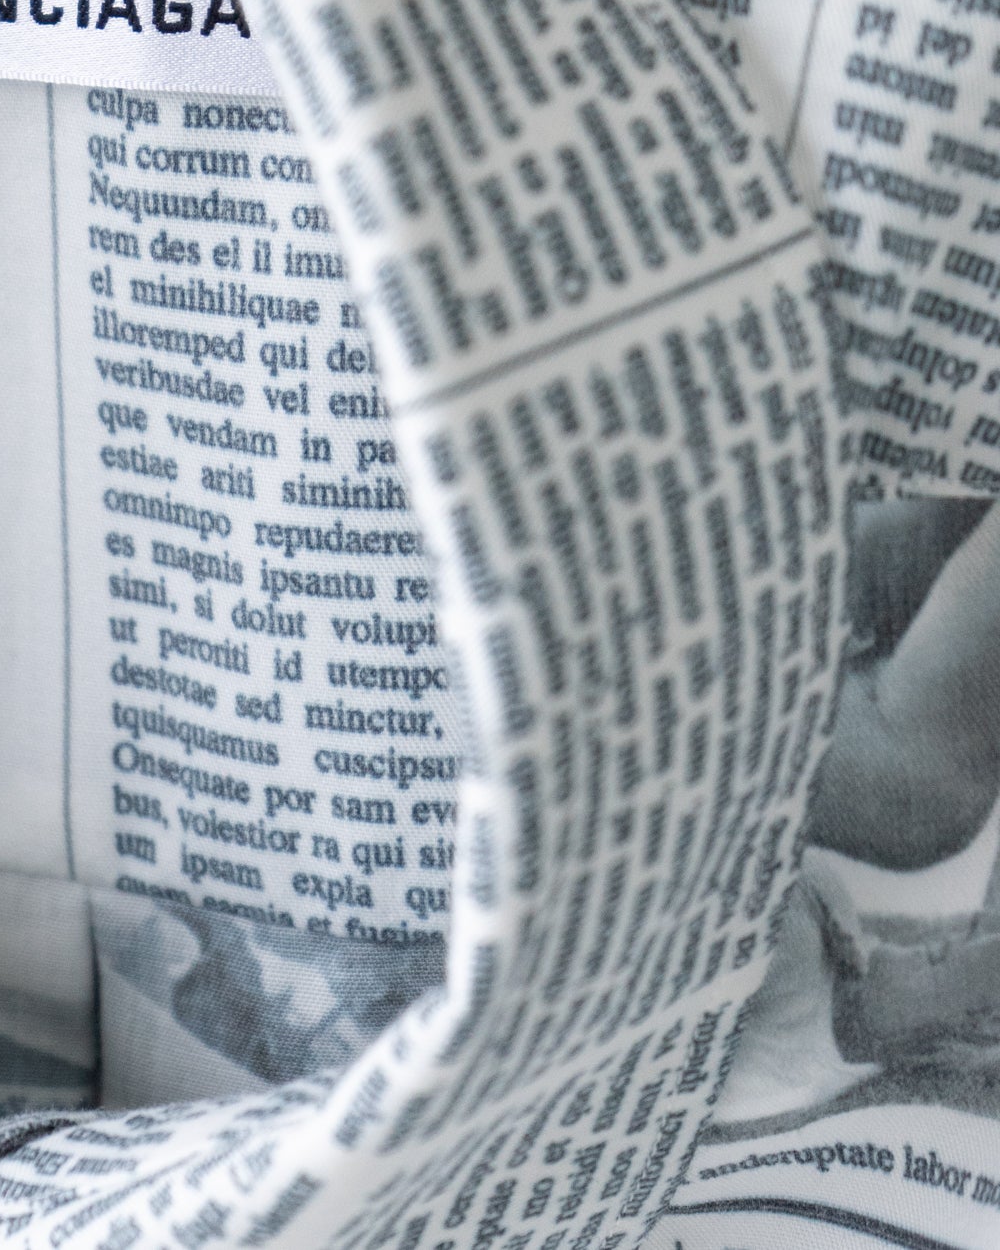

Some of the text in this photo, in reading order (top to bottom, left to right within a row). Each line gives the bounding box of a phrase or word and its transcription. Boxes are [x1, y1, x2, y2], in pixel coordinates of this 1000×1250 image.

[86, 88, 160, 131] culpa
[88, 133, 127, 169] qui
[135, 145, 252, 179] corrum
[88, 224, 141, 260] rem
[149, 230, 201, 266] des
[212, 236, 241, 272] el
[91, 265, 115, 298] el
[93, 305, 246, 366] illoremped
[259, 335, 310, 377] qui
[95, 354, 246, 407] veribusdae
[263, 381, 311, 416] vel
[98, 399, 150, 434] que
[165, 411, 278, 458] vendam
[300, 427, 332, 462] in
[99, 443, 179, 482] estiae
[200, 463, 256, 501] ariti
[103, 486, 233, 541] omnimpo
[105, 528, 136, 558] es
[150, 536, 245, 586] magnis
[259, 557, 376, 601] ipsantu
[107, 566, 178, 614] simi,
[192, 588, 215, 622] si
[230, 599, 307, 641] dolut
[109, 614, 138, 645] ut
[274, 648, 304, 683] id
[110, 653, 445, 740] destotae sed minctur,
[111, 699, 281, 768] tquisquamus
[111, 741, 252, 800] Onsequate
[264, 783, 316, 819] por
[330, 794, 397, 826] sam
[113, 783, 169, 830] bus,
[177, 809, 302, 856] volestior
[311, 833, 342, 863] ra
[352, 835, 407, 876] qui
[115, 830, 158, 868] um
[180, 843, 265, 891] ipsam
[291, 869, 375, 912] expla
[902, 1142, 973, 1197] labor
